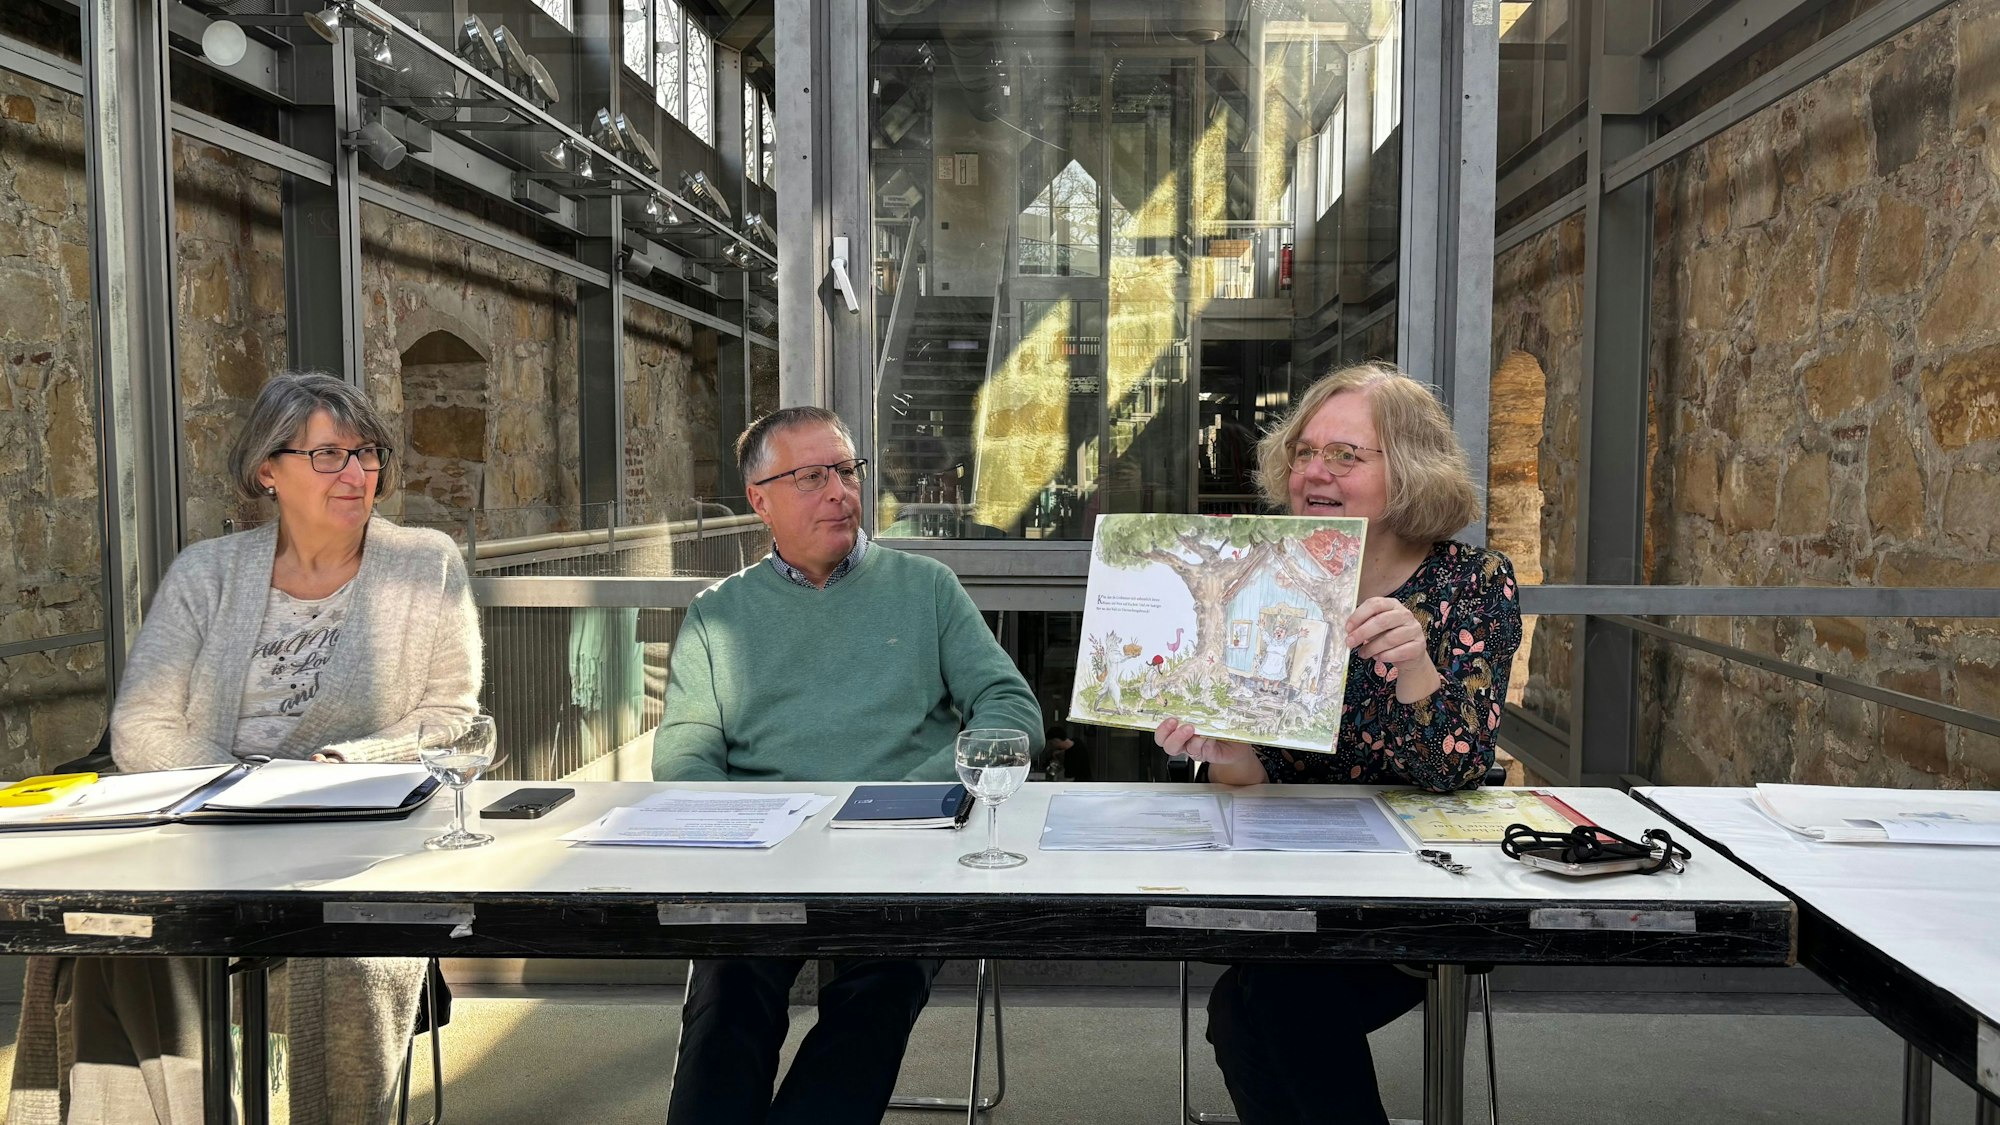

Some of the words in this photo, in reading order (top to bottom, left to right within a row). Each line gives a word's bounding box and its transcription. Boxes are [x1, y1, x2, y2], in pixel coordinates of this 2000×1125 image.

[251, 640, 284, 659] All
[271, 662, 286, 676] is
[291, 652, 331, 676] Lov
[280, 672, 322, 713] and
